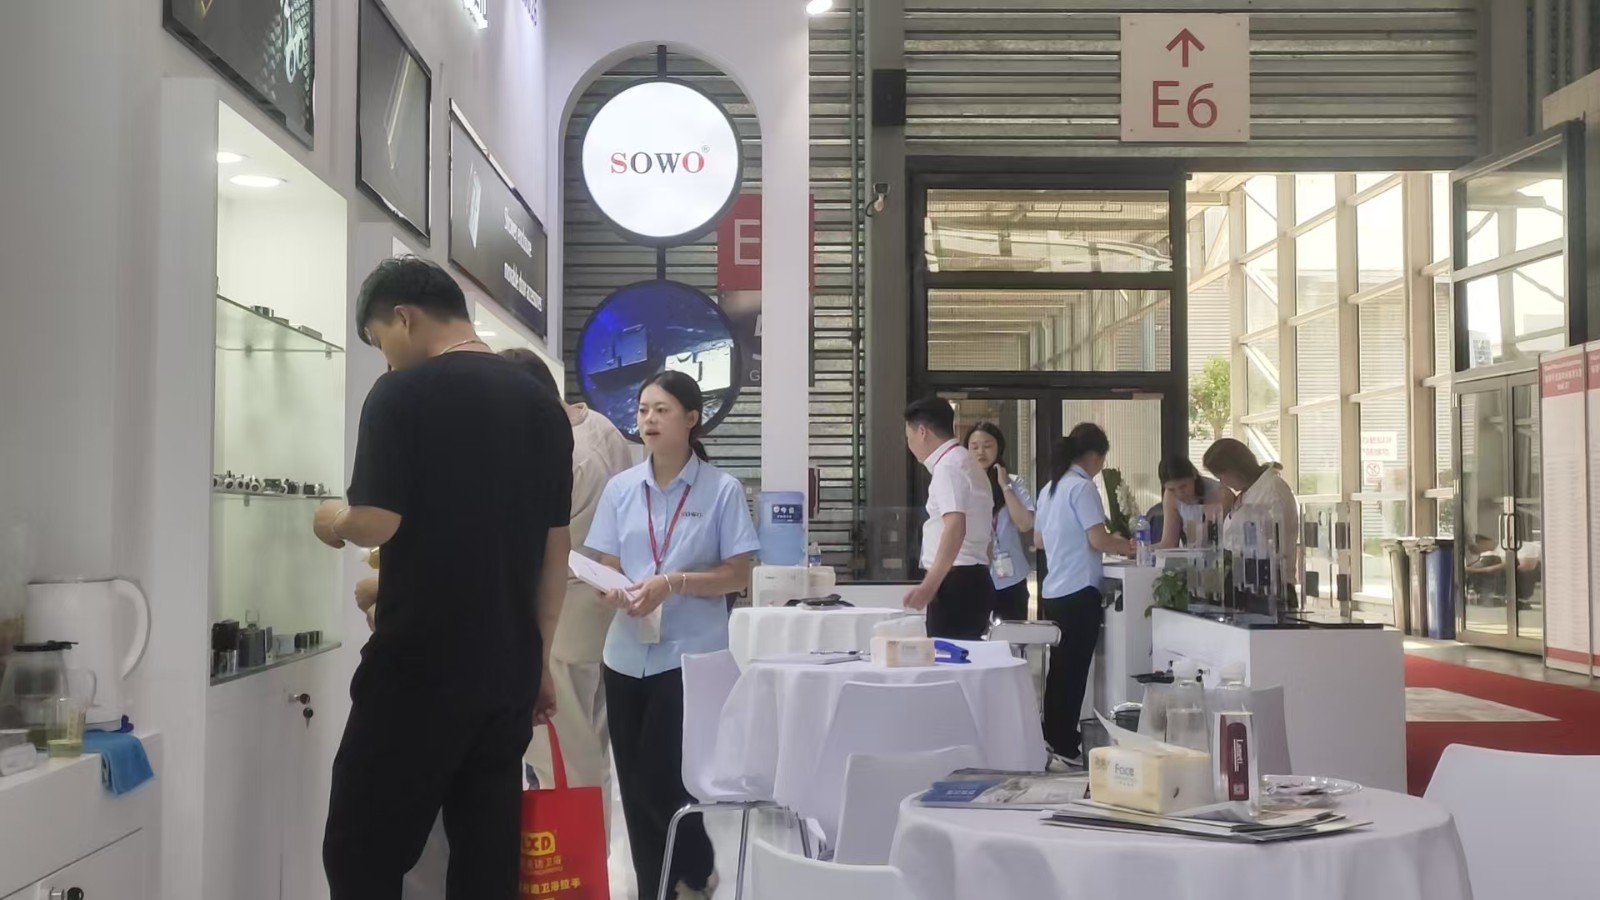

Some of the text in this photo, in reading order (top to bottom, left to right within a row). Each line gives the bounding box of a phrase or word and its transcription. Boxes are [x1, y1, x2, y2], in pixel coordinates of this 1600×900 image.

[1153, 81, 1217, 128] E6
[611, 151, 705, 174] SOWO
[1114, 763, 1135, 777] Face
